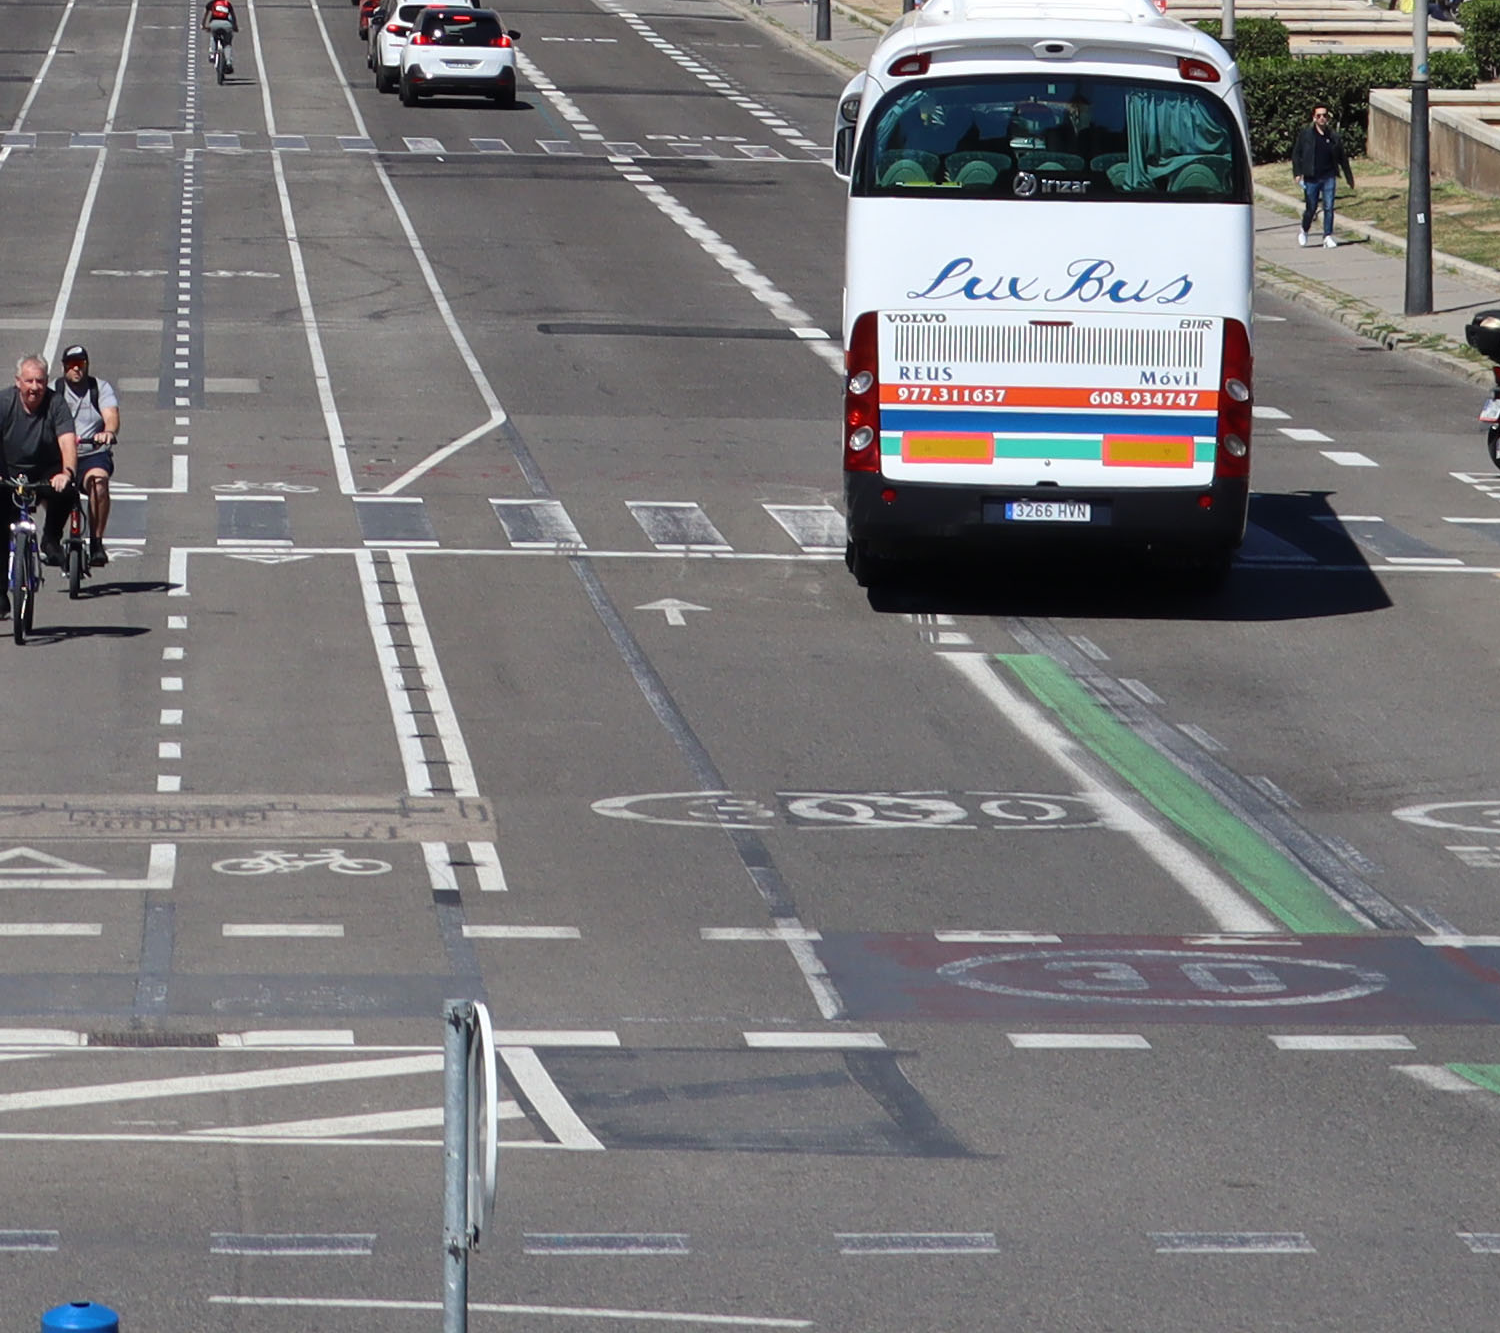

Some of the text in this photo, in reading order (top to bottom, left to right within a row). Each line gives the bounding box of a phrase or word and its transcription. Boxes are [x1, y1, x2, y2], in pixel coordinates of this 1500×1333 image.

[1041, 178, 1091, 194] irizar
[906, 257, 1193, 304] Lux Bus
[886, 313, 947, 324] VOLVO
[899, 366, 953, 381] REUS
[1139, 371, 1199, 386] Móvil
[897, 388, 1006, 403] 977.311657
[1089, 391, 1198, 407] 608.934747
[1015, 503, 1087, 519] 3266 HVN
